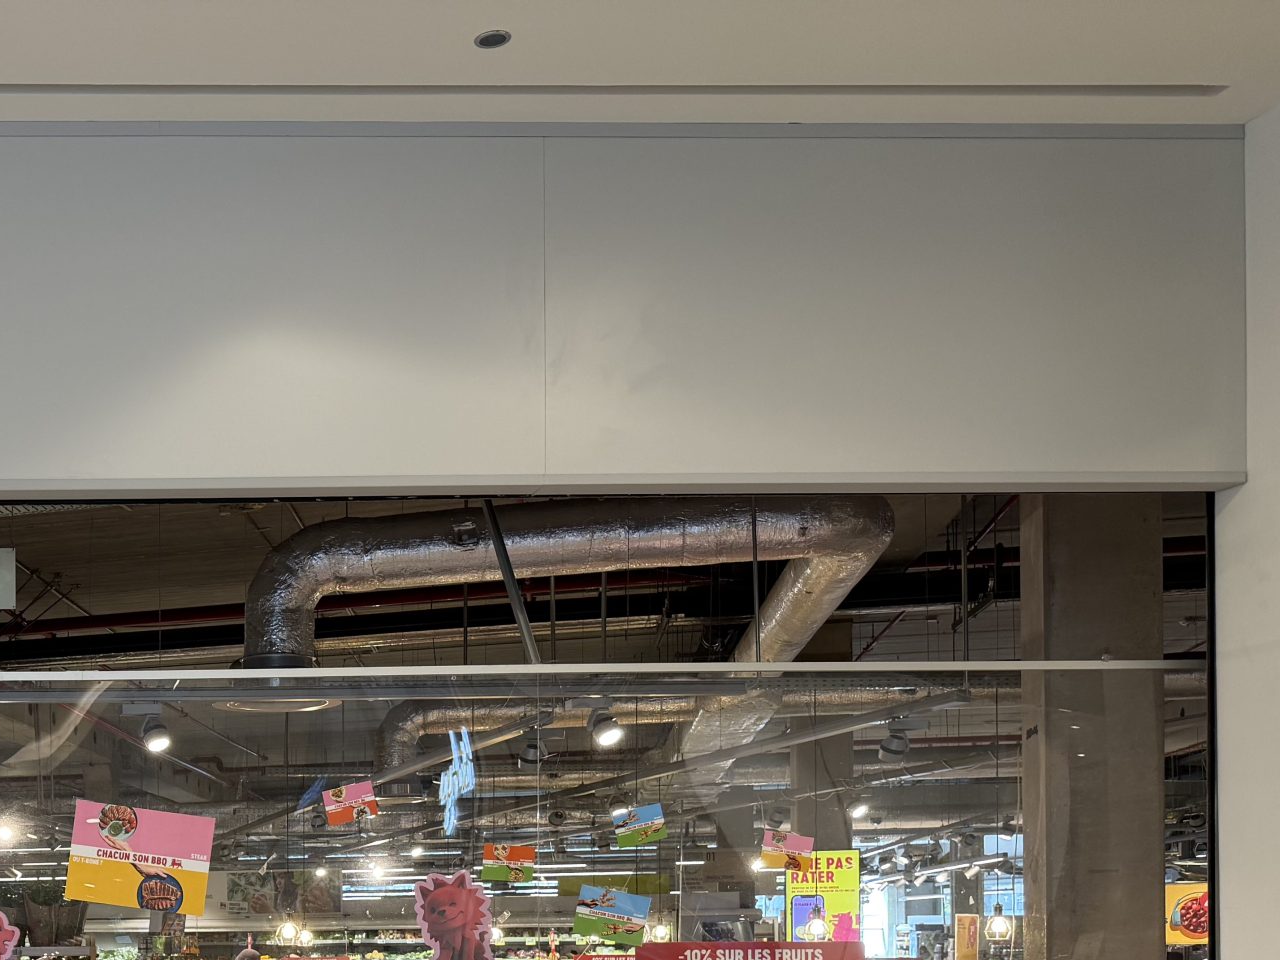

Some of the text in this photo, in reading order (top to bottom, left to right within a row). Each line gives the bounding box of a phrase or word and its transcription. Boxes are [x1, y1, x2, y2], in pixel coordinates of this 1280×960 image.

[96, 848, 168, 867] CHACUN SON BBQ
[826, 856, 854, 870] PAS
[791, 871, 835, 884] RATER
